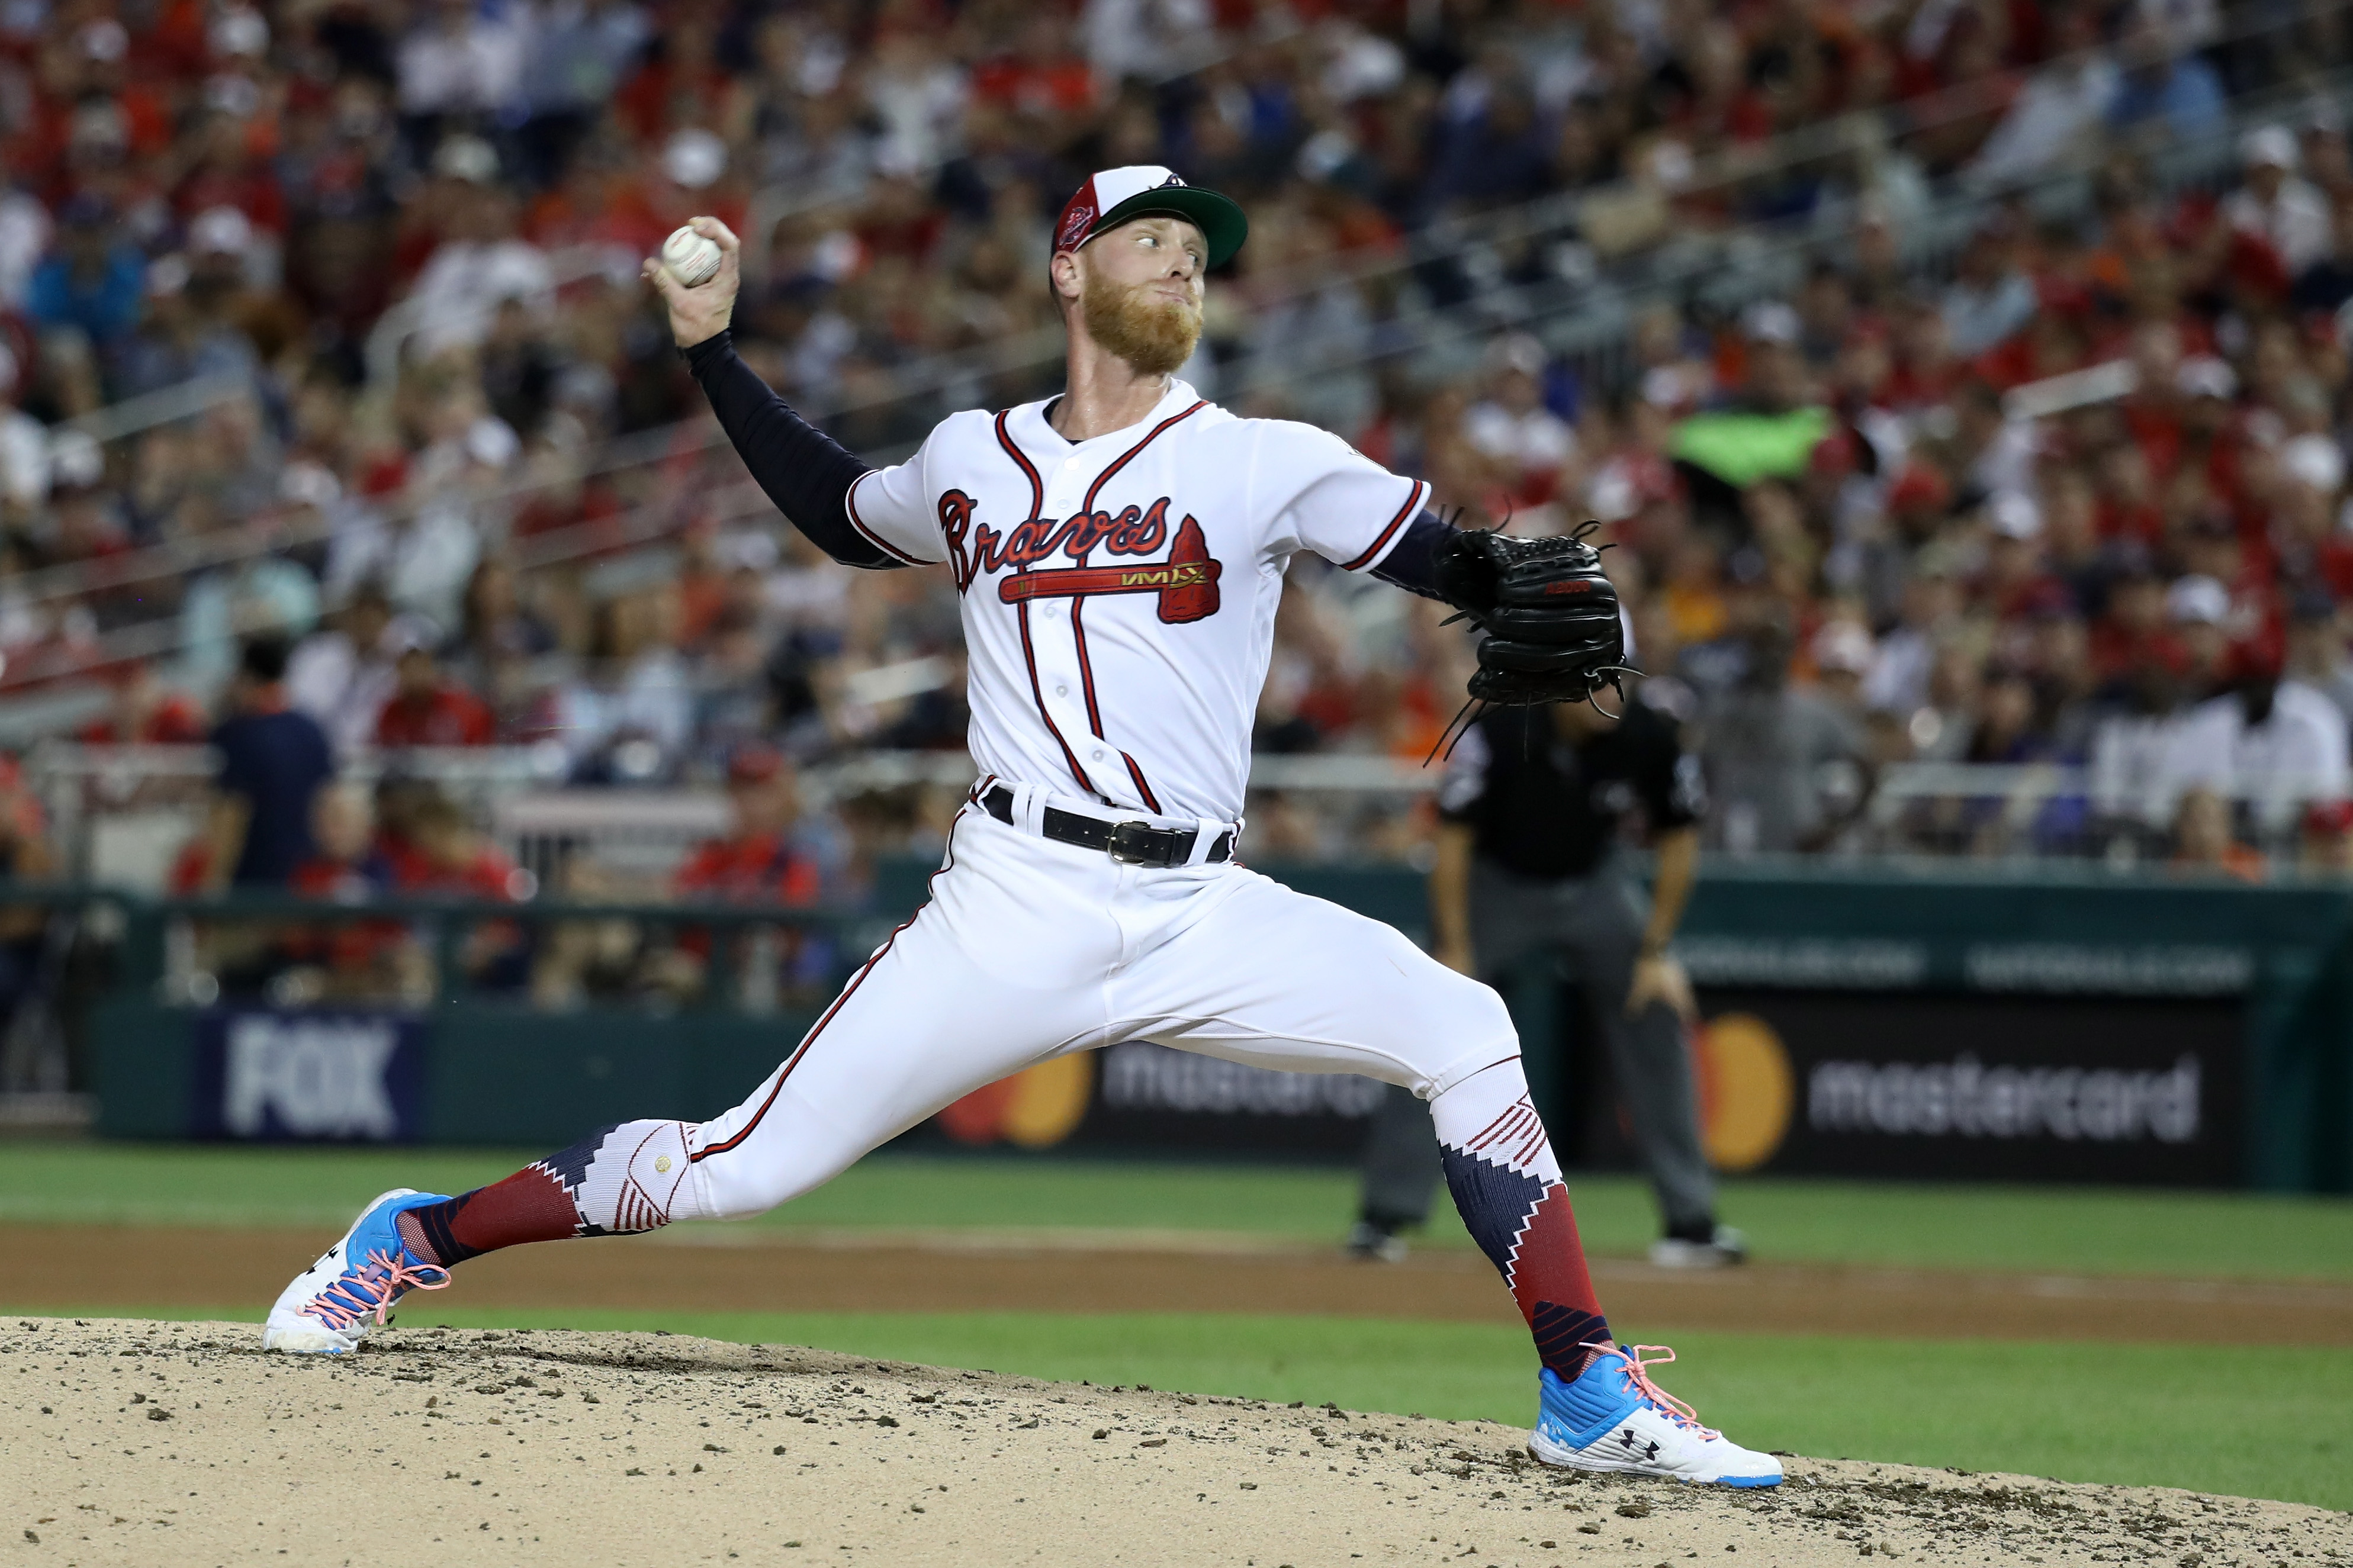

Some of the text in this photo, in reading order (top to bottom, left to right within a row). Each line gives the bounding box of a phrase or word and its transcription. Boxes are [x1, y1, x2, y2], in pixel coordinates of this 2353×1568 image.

[938, 489, 1170, 599] Braves
[227, 1016, 396, 1134] FOX
[1809, 1055, 2201, 1140] mastercard
